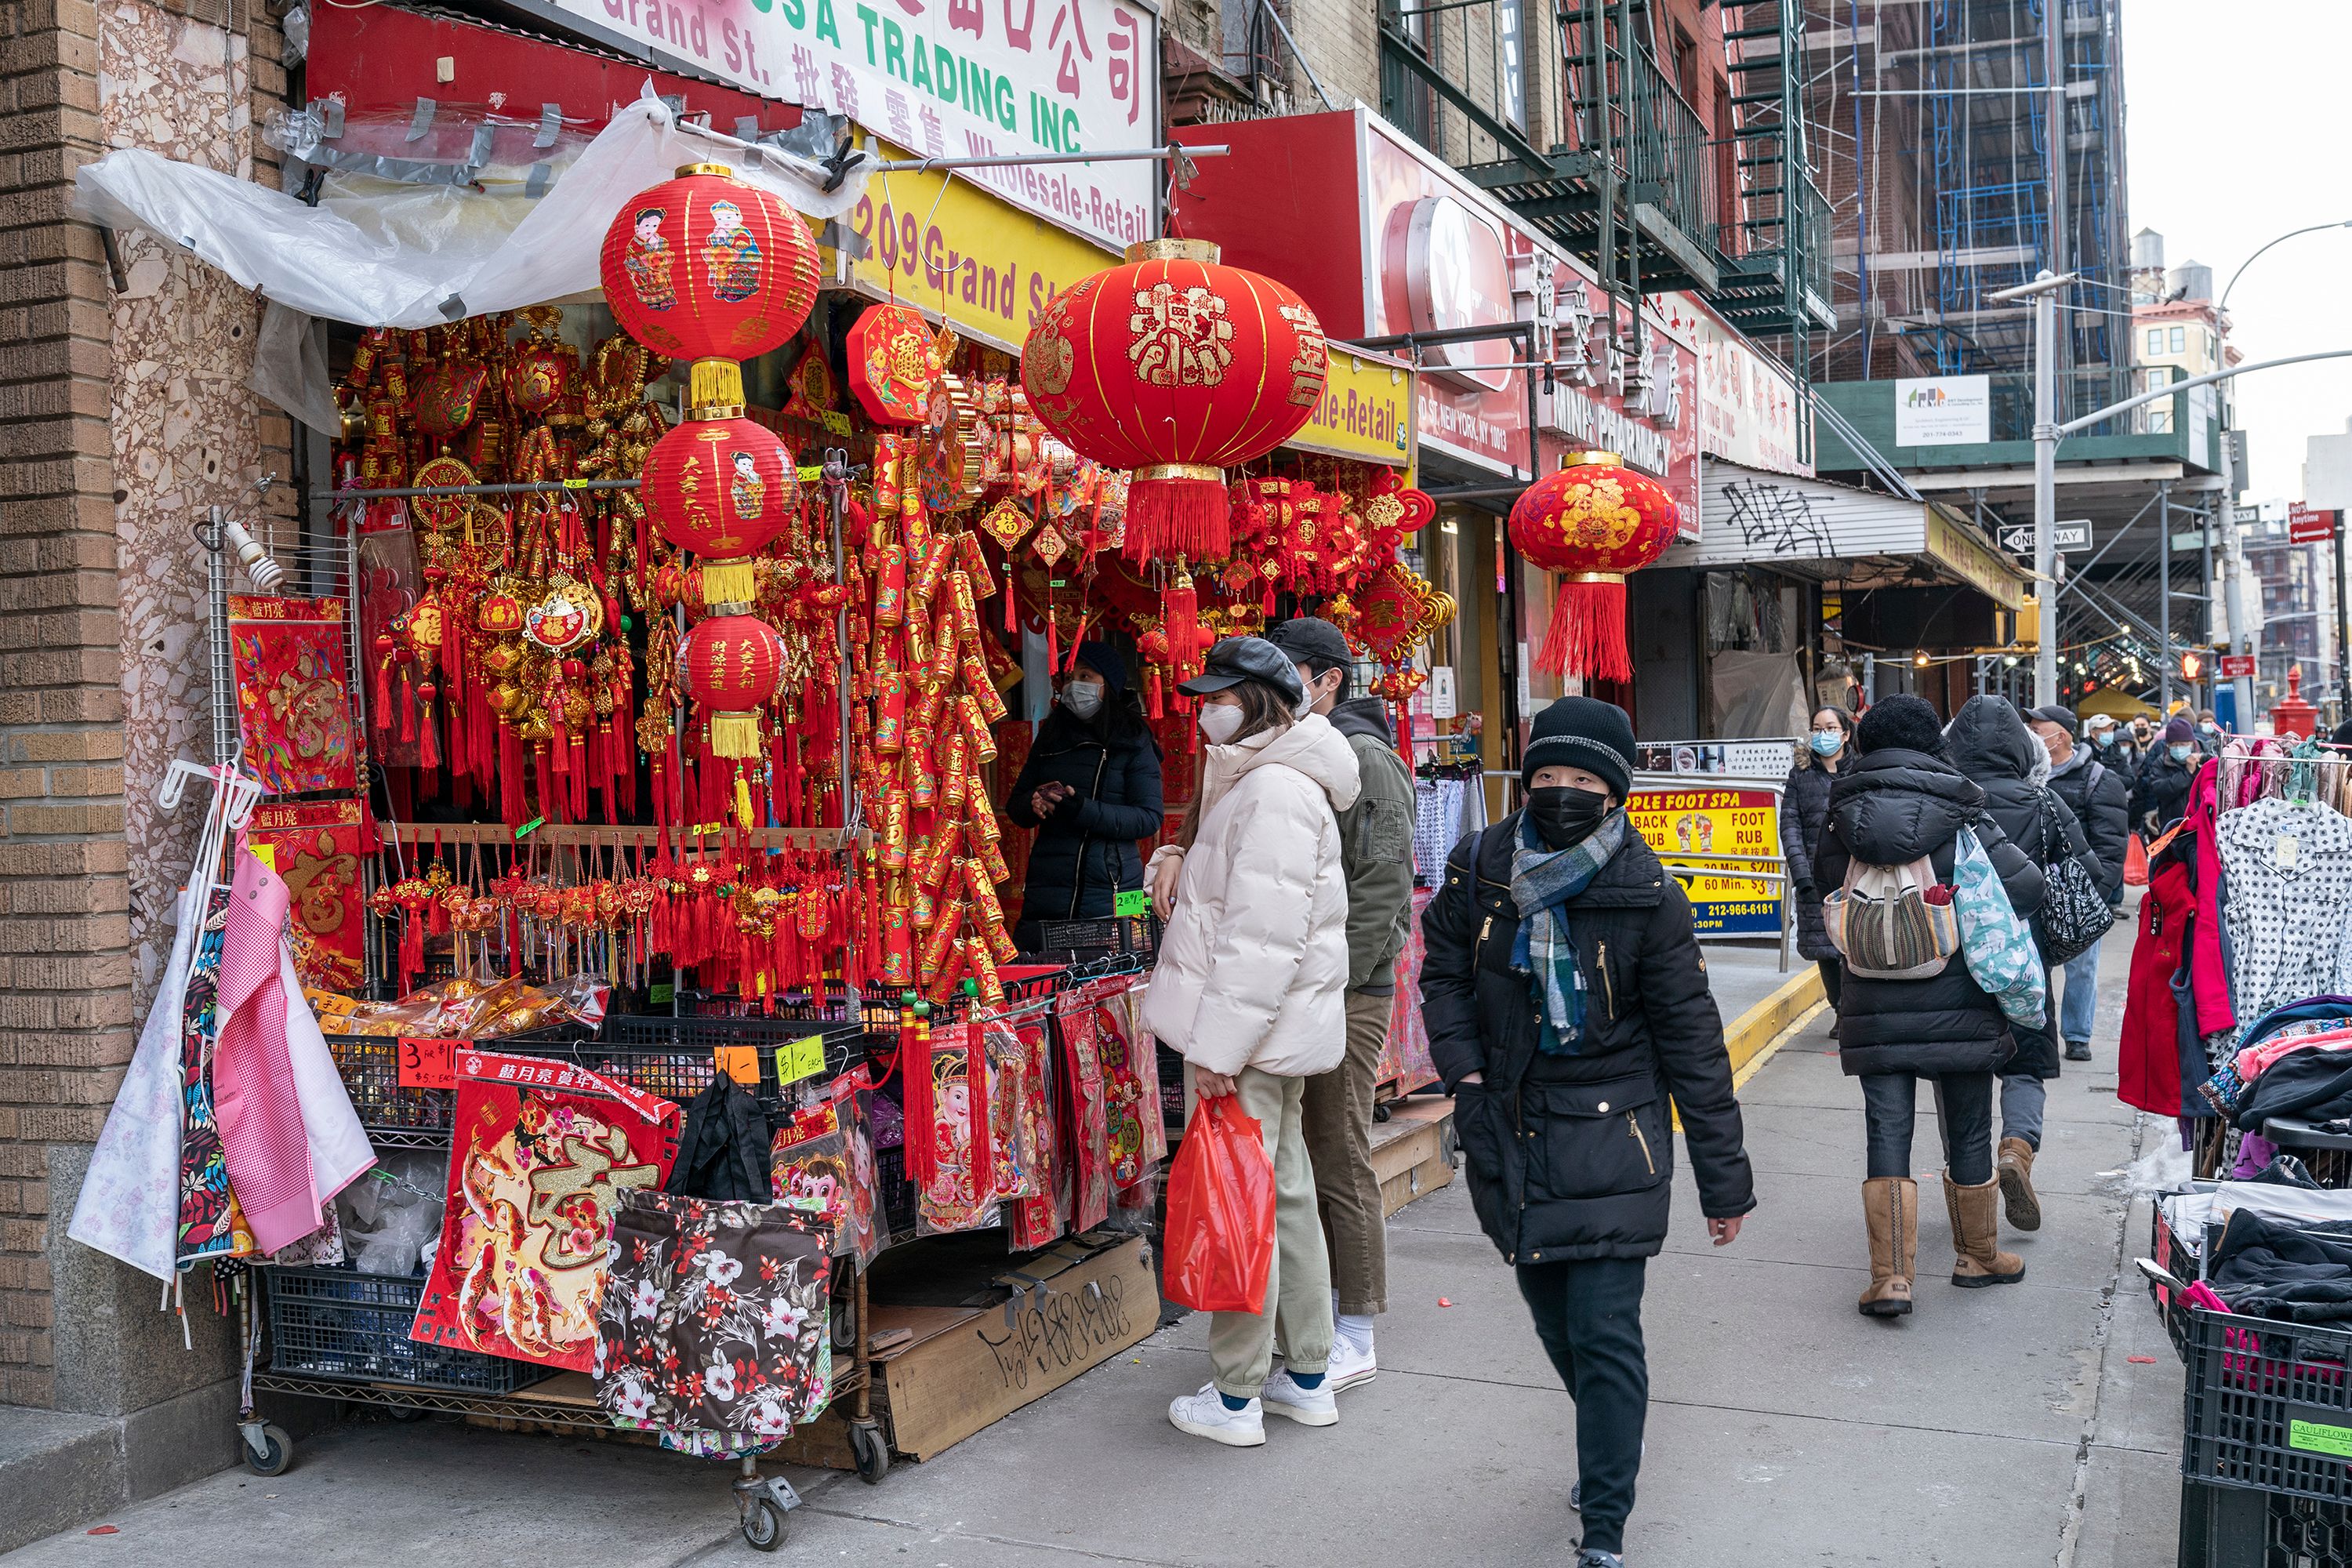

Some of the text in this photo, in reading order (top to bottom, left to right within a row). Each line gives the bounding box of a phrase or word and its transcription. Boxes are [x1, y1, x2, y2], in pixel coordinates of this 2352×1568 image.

[721, 17, 771, 86] St.
[857, 2, 1017, 133] TRADING
[387, 375, 406, 397] 福
[1440, 404, 1457, 433] NEW
[1479, 419, 1488, 445] NY
[1490, 424, 1508, 453] 10013
[1597, 402, 1671, 477] PHARMACY
[677, 456, 714, 532] 大吉大利
[995, 512, 1018, 535] 福
[2291, 514, 2320, 525] Anytime
[1040, 536, 1058, 555] 福
[2013, 534, 2036, 546] ONE
[251, 601, 285, 620] 藍月亮
[1367, 599, 1402, 629] 春
[739, 638, 757, 690] 大吉大利
[2227, 662, 2251, 670] WRONG
[1665, 793, 1707, 810] FOOT
[1710, 792, 1740, 808] SPA
[260, 810, 299, 827] 藍月亮
[1635, 815, 1668, 829] BACK
[1731, 812, 1766, 826] FOOT
[1736, 830, 1763, 844] RUB
[1704, 879, 1718, 890] 60
[1721, 878, 1744, 890] Min.
[405, 1043, 422, 1069] 3
[424, 1049, 436, 1059] FOR
[808, 1058, 822, 1071] EACH
[498, 1063, 553, 1084] 藍月亮
